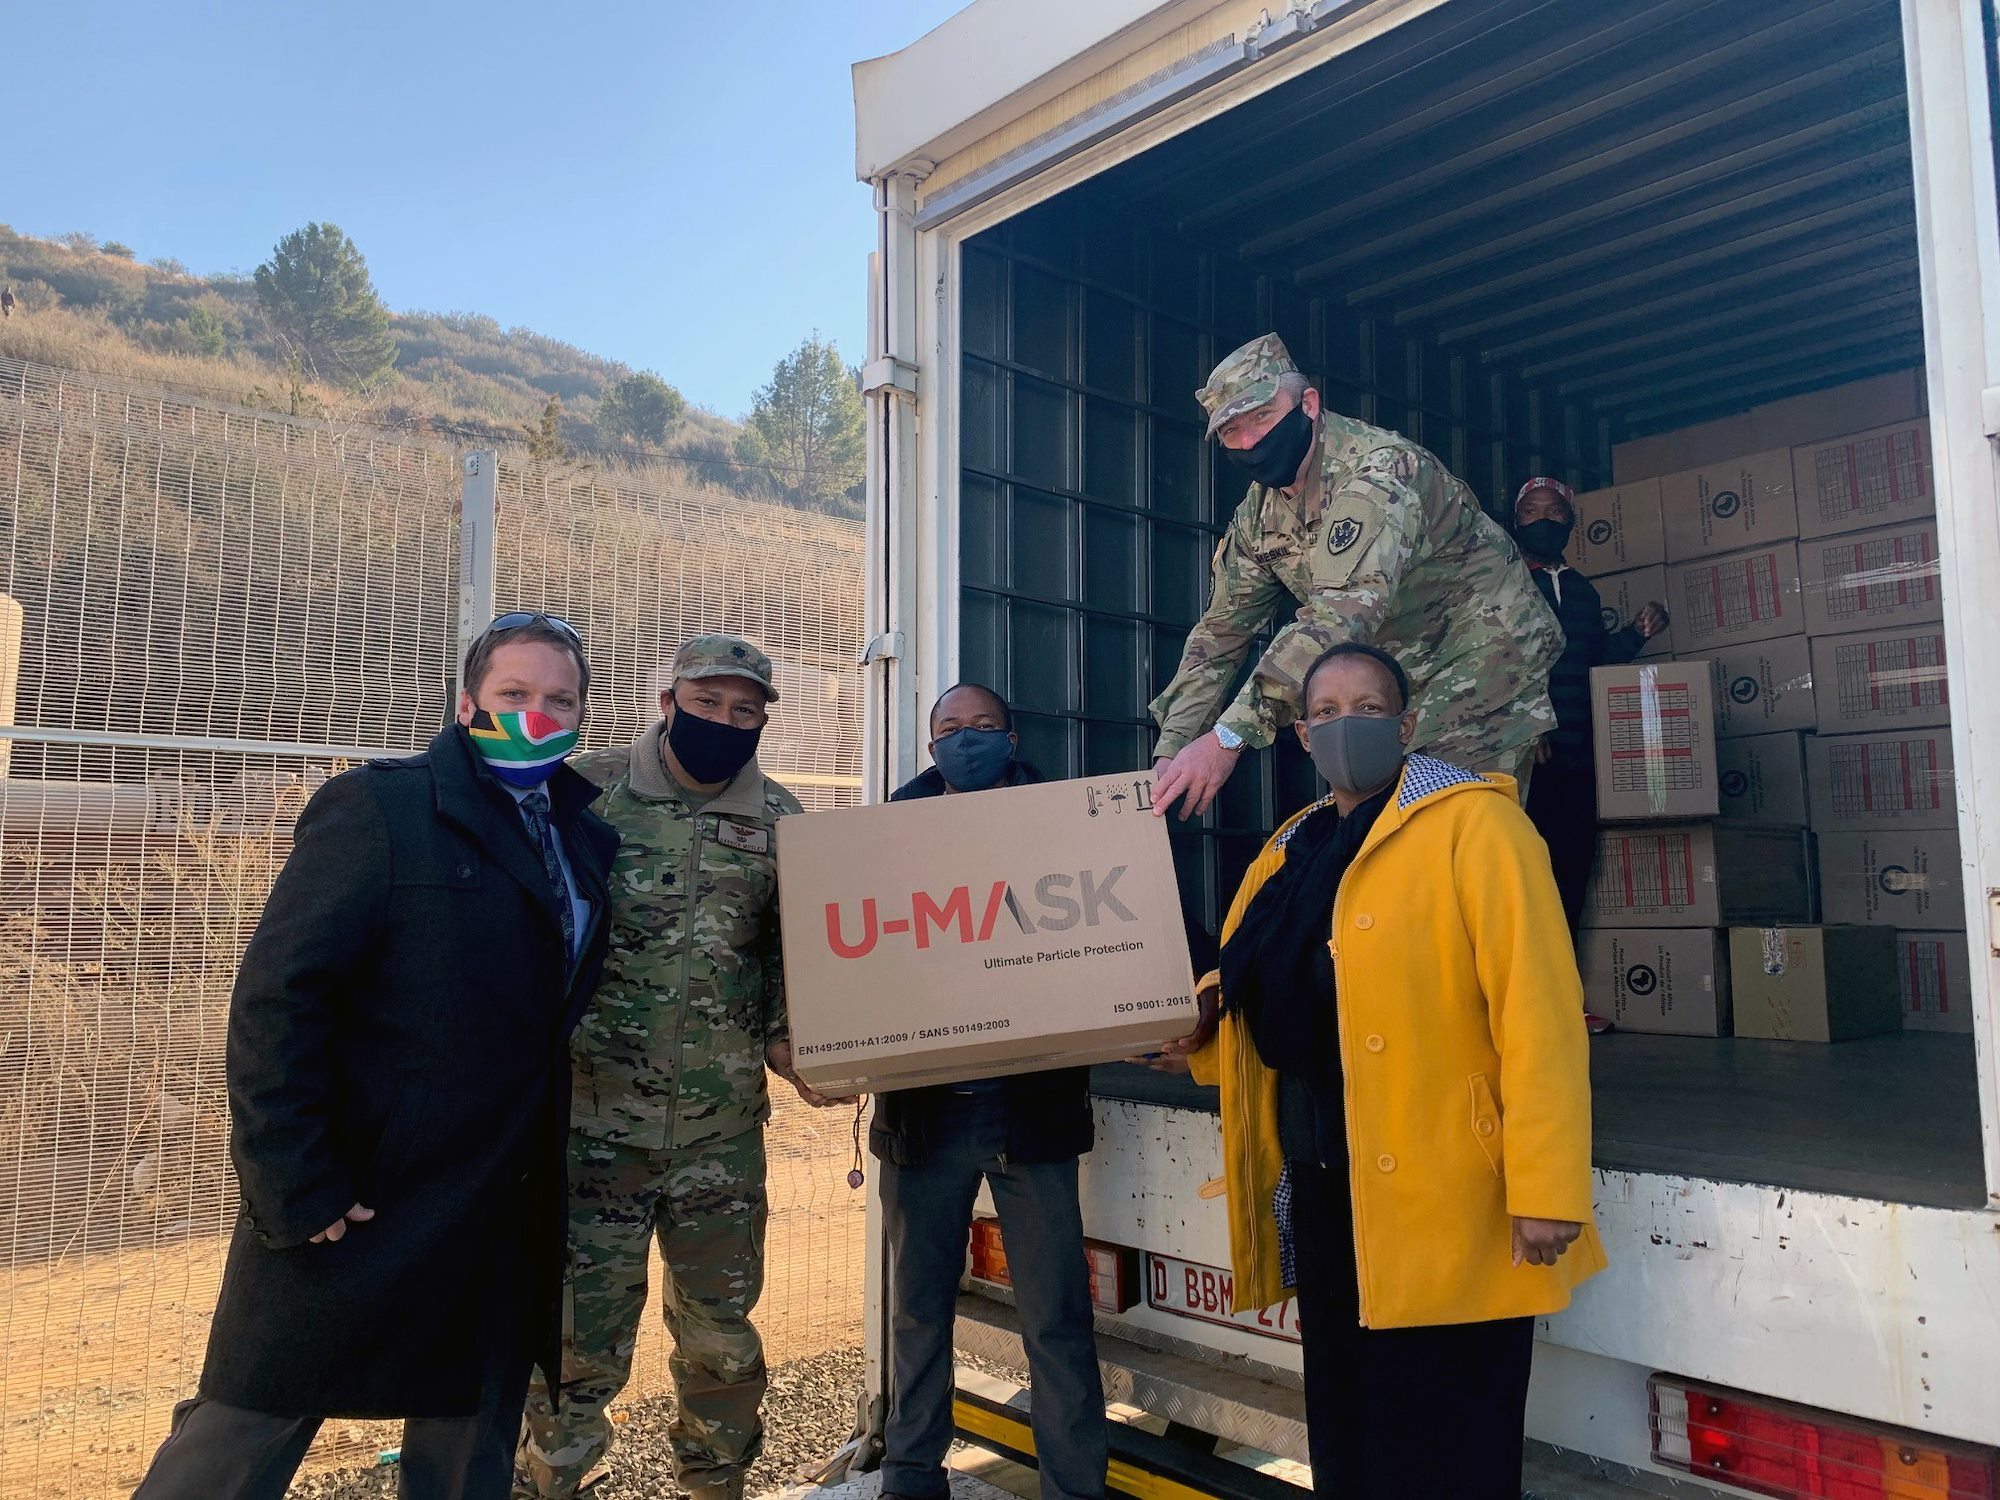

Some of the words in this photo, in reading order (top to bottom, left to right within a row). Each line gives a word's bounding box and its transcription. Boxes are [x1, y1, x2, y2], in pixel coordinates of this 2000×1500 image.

[824, 864, 1138, 959] U-MASK
[983, 953, 1034, 970] Ultimate
[1036, 947, 1081, 964] Particle
[1084, 940, 1144, 958] Protection
[1113, 1003, 1133, 1014] ISO
[798, 1032, 909, 1056] EN149:2001+A1:2009
[912, 1030, 916, 1041] /
[919, 1026, 950, 1040] SANS
[952, 1019, 1010, 1036] 50149:2003
[1154, 1262, 1166, 1300] D
